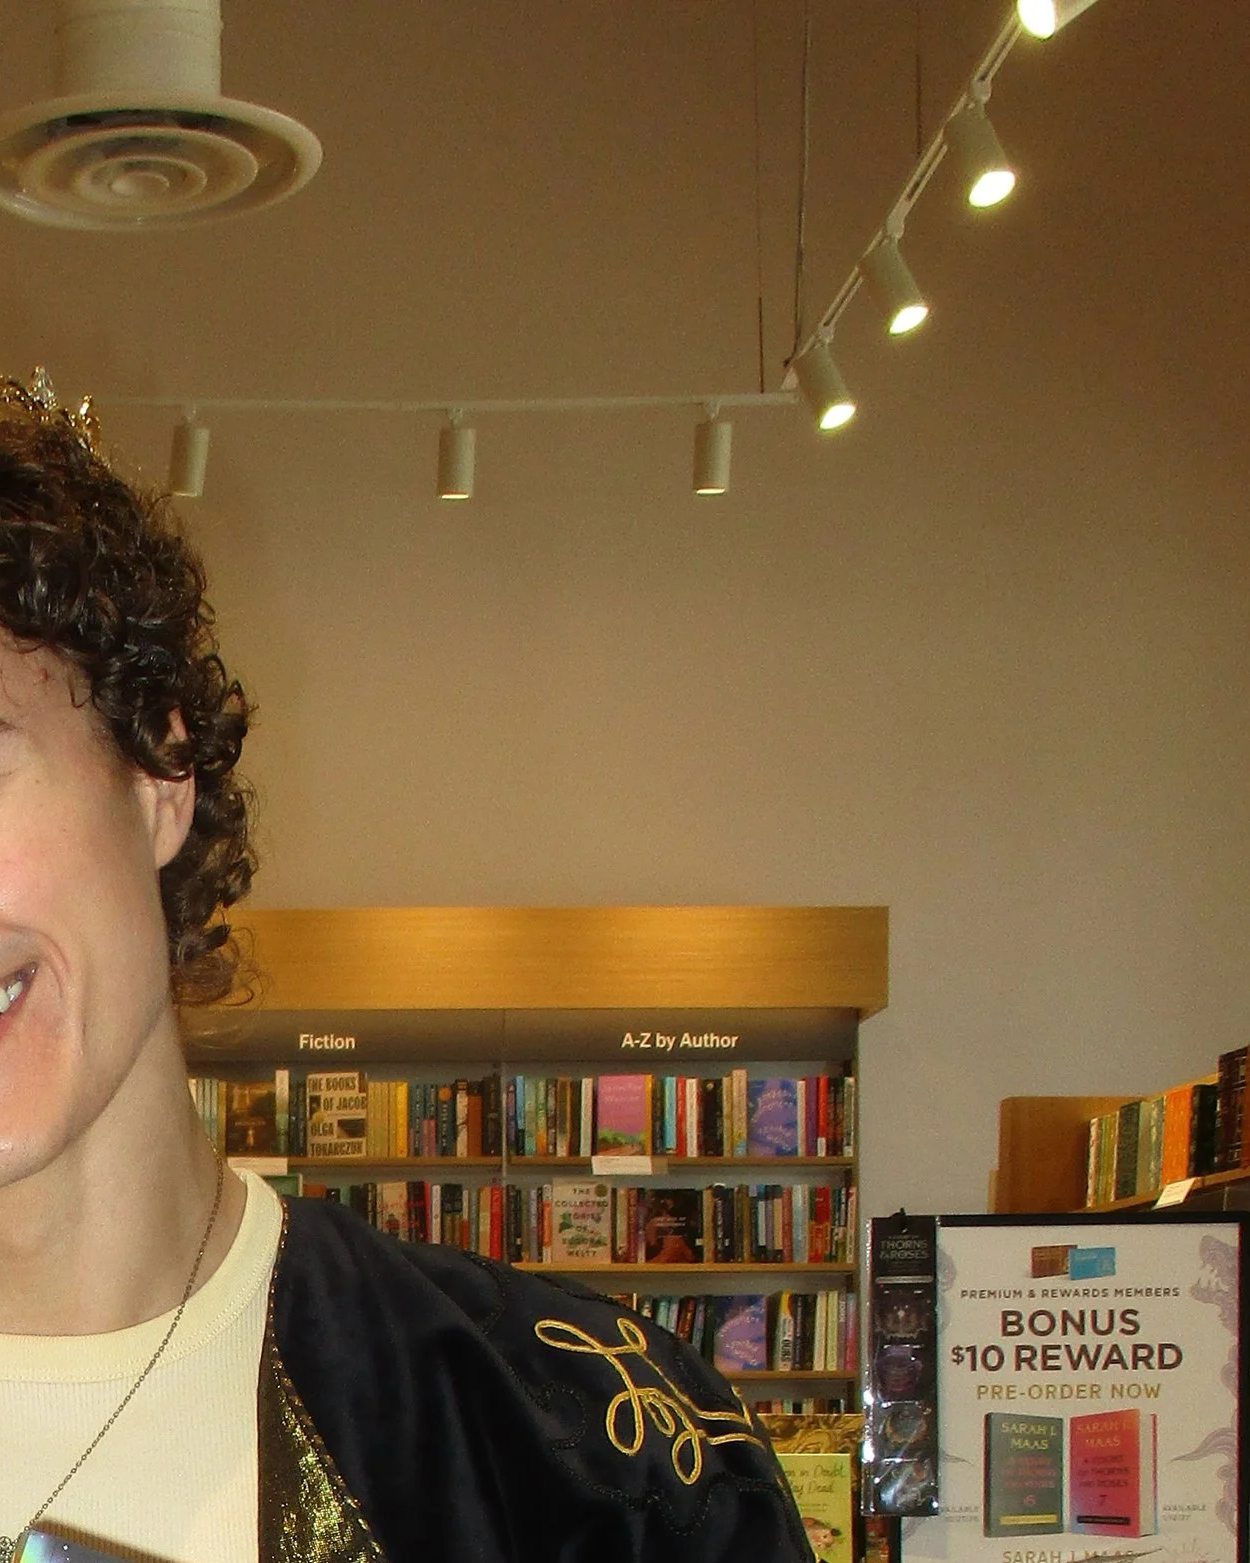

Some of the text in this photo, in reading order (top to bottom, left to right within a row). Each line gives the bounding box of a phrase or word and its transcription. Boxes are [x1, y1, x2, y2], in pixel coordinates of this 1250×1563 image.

[299, 1034, 356, 1050] Fiction
[621, 1032, 739, 1051] A-Z by Author
[326, 1076, 357, 1091] BOOKS
[336, 1096, 367, 1111] JACOB
[961, 1287, 1181, 1299] PREMIUM & REWARDS MEMBERS
[1001, 1308, 1141, 1337] BONUS
[951, 1343, 1183, 1372] $10 REWARD
[977, 1383, 1162, 1400] PRE-ORDER NOW
[1001, 1422, 1047, 1435] SARAH
[1010, 1439, 1049, 1450] MAAS
